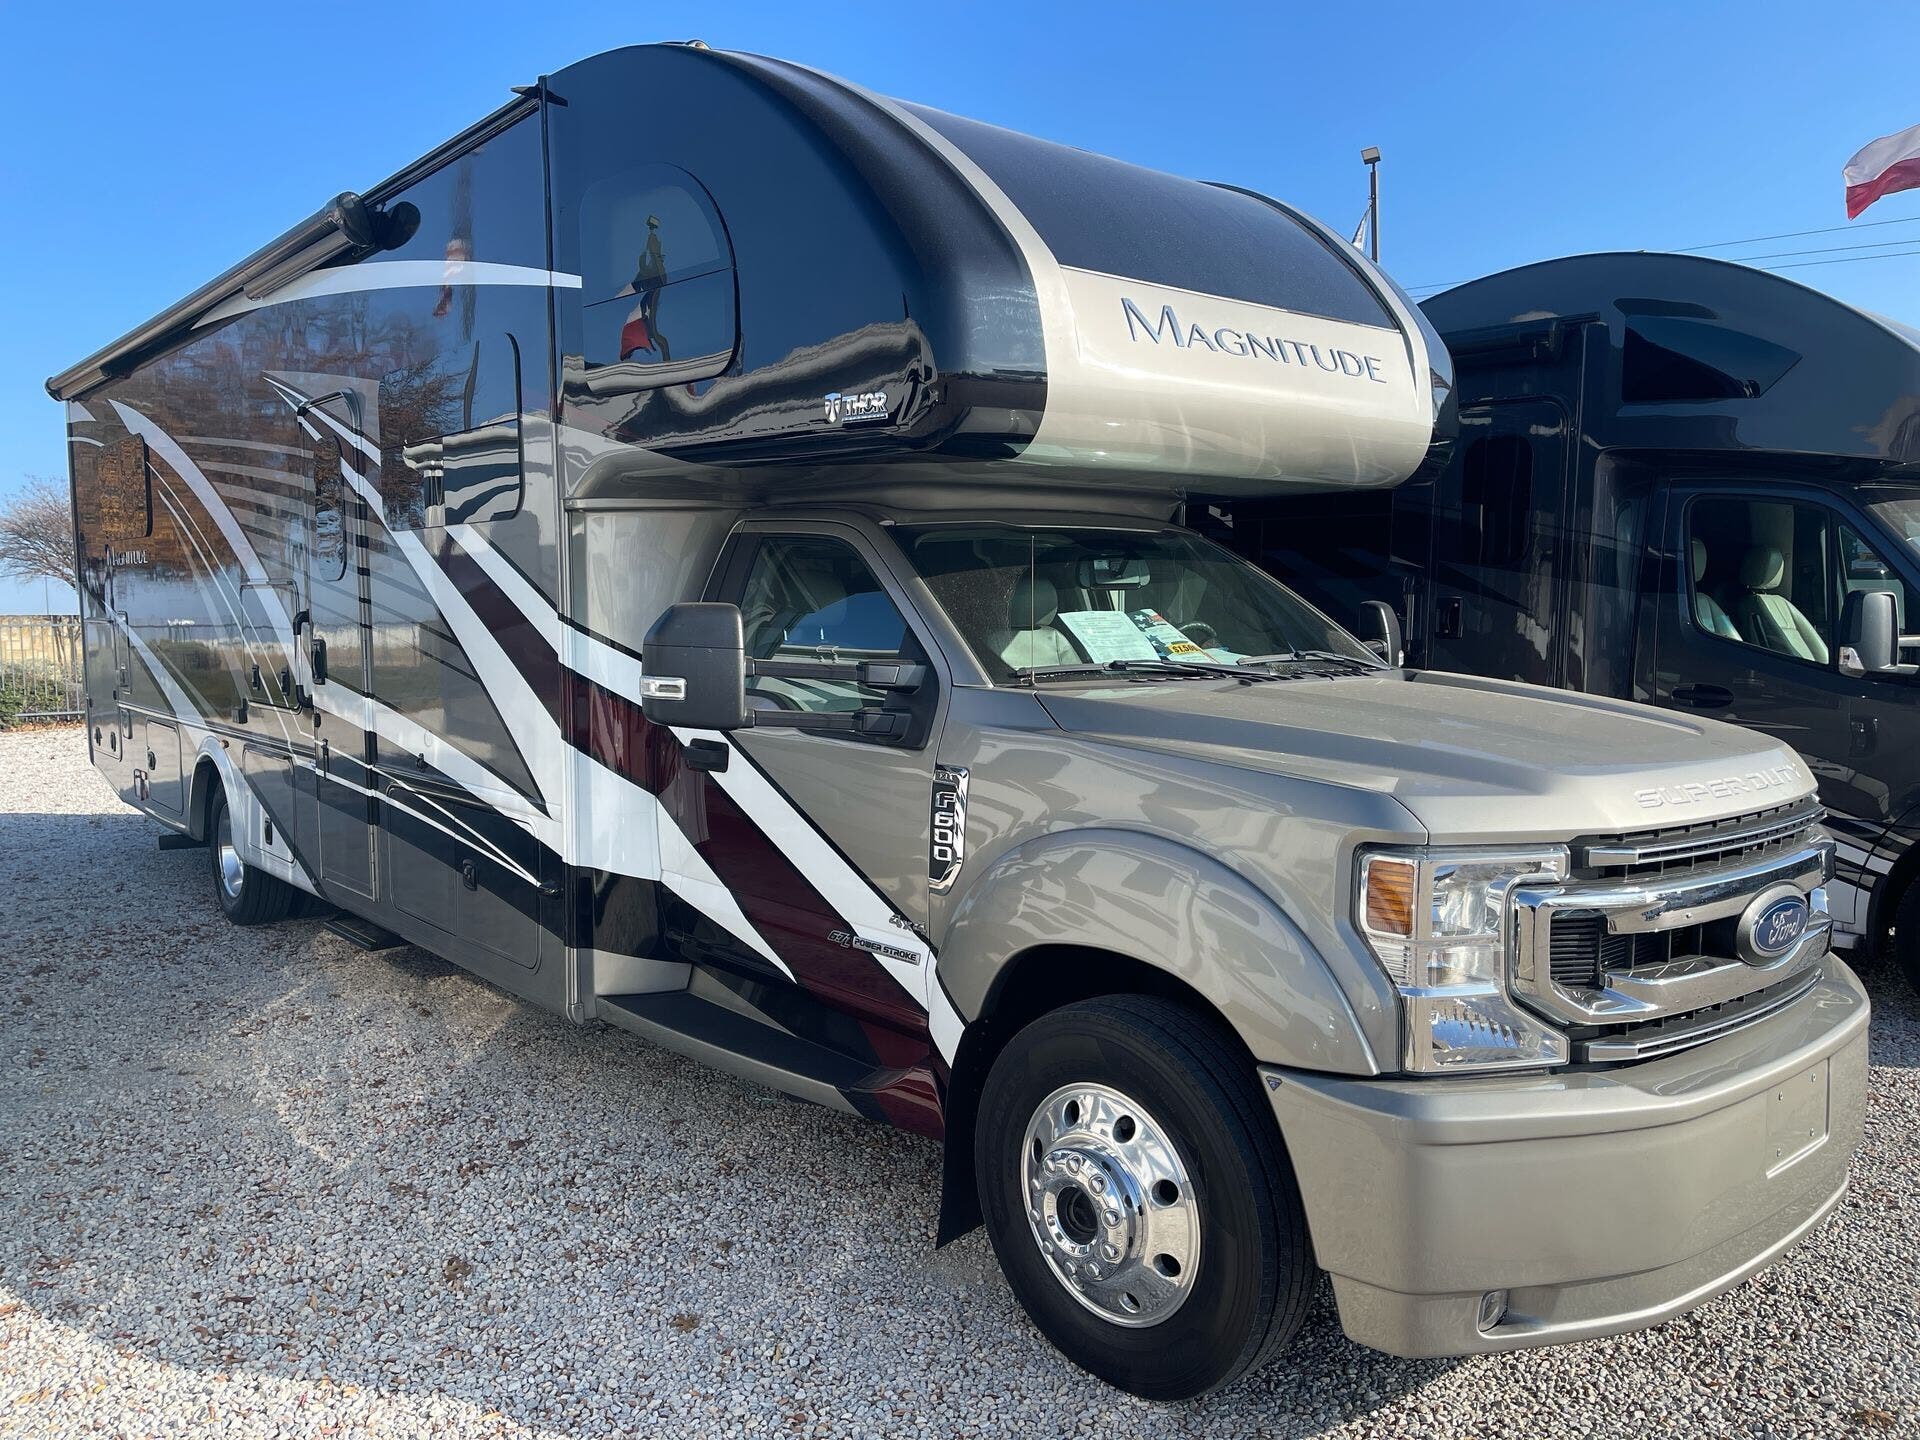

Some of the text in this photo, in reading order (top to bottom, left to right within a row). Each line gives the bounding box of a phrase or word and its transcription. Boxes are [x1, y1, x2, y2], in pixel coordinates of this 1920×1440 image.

[1120, 297, 1387, 384] MAGNITUDE
[842, 392, 887, 415] THOR
[1635, 763, 1802, 809] SUPER DUTY
[933, 791, 957, 861] F600
[1768, 909, 1800, 945] Ford
[854, 938, 882, 953] POWER
[882, 947, 917, 962] STROKE
